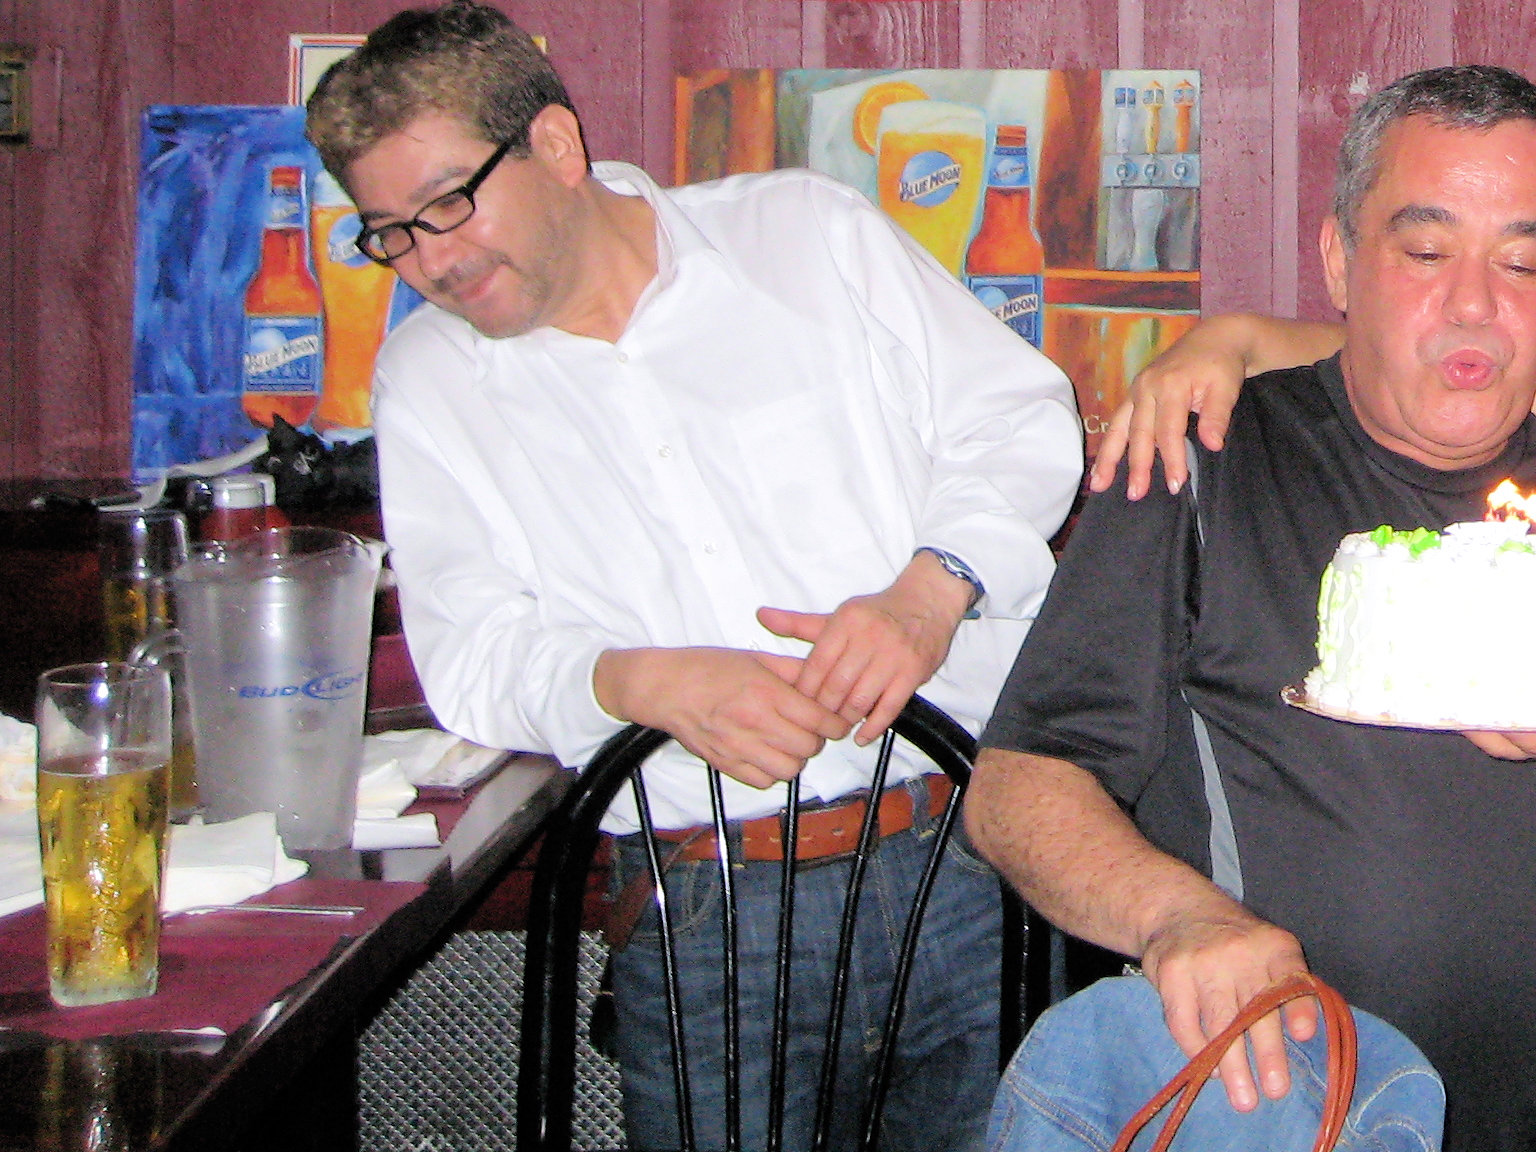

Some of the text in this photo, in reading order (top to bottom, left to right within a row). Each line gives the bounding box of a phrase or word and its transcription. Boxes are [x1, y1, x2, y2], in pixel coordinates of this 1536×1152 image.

[929, 167, 961, 190] MOON
[1003, 296, 1037, 318] MOON
[239, 685, 299, 699] BUD
